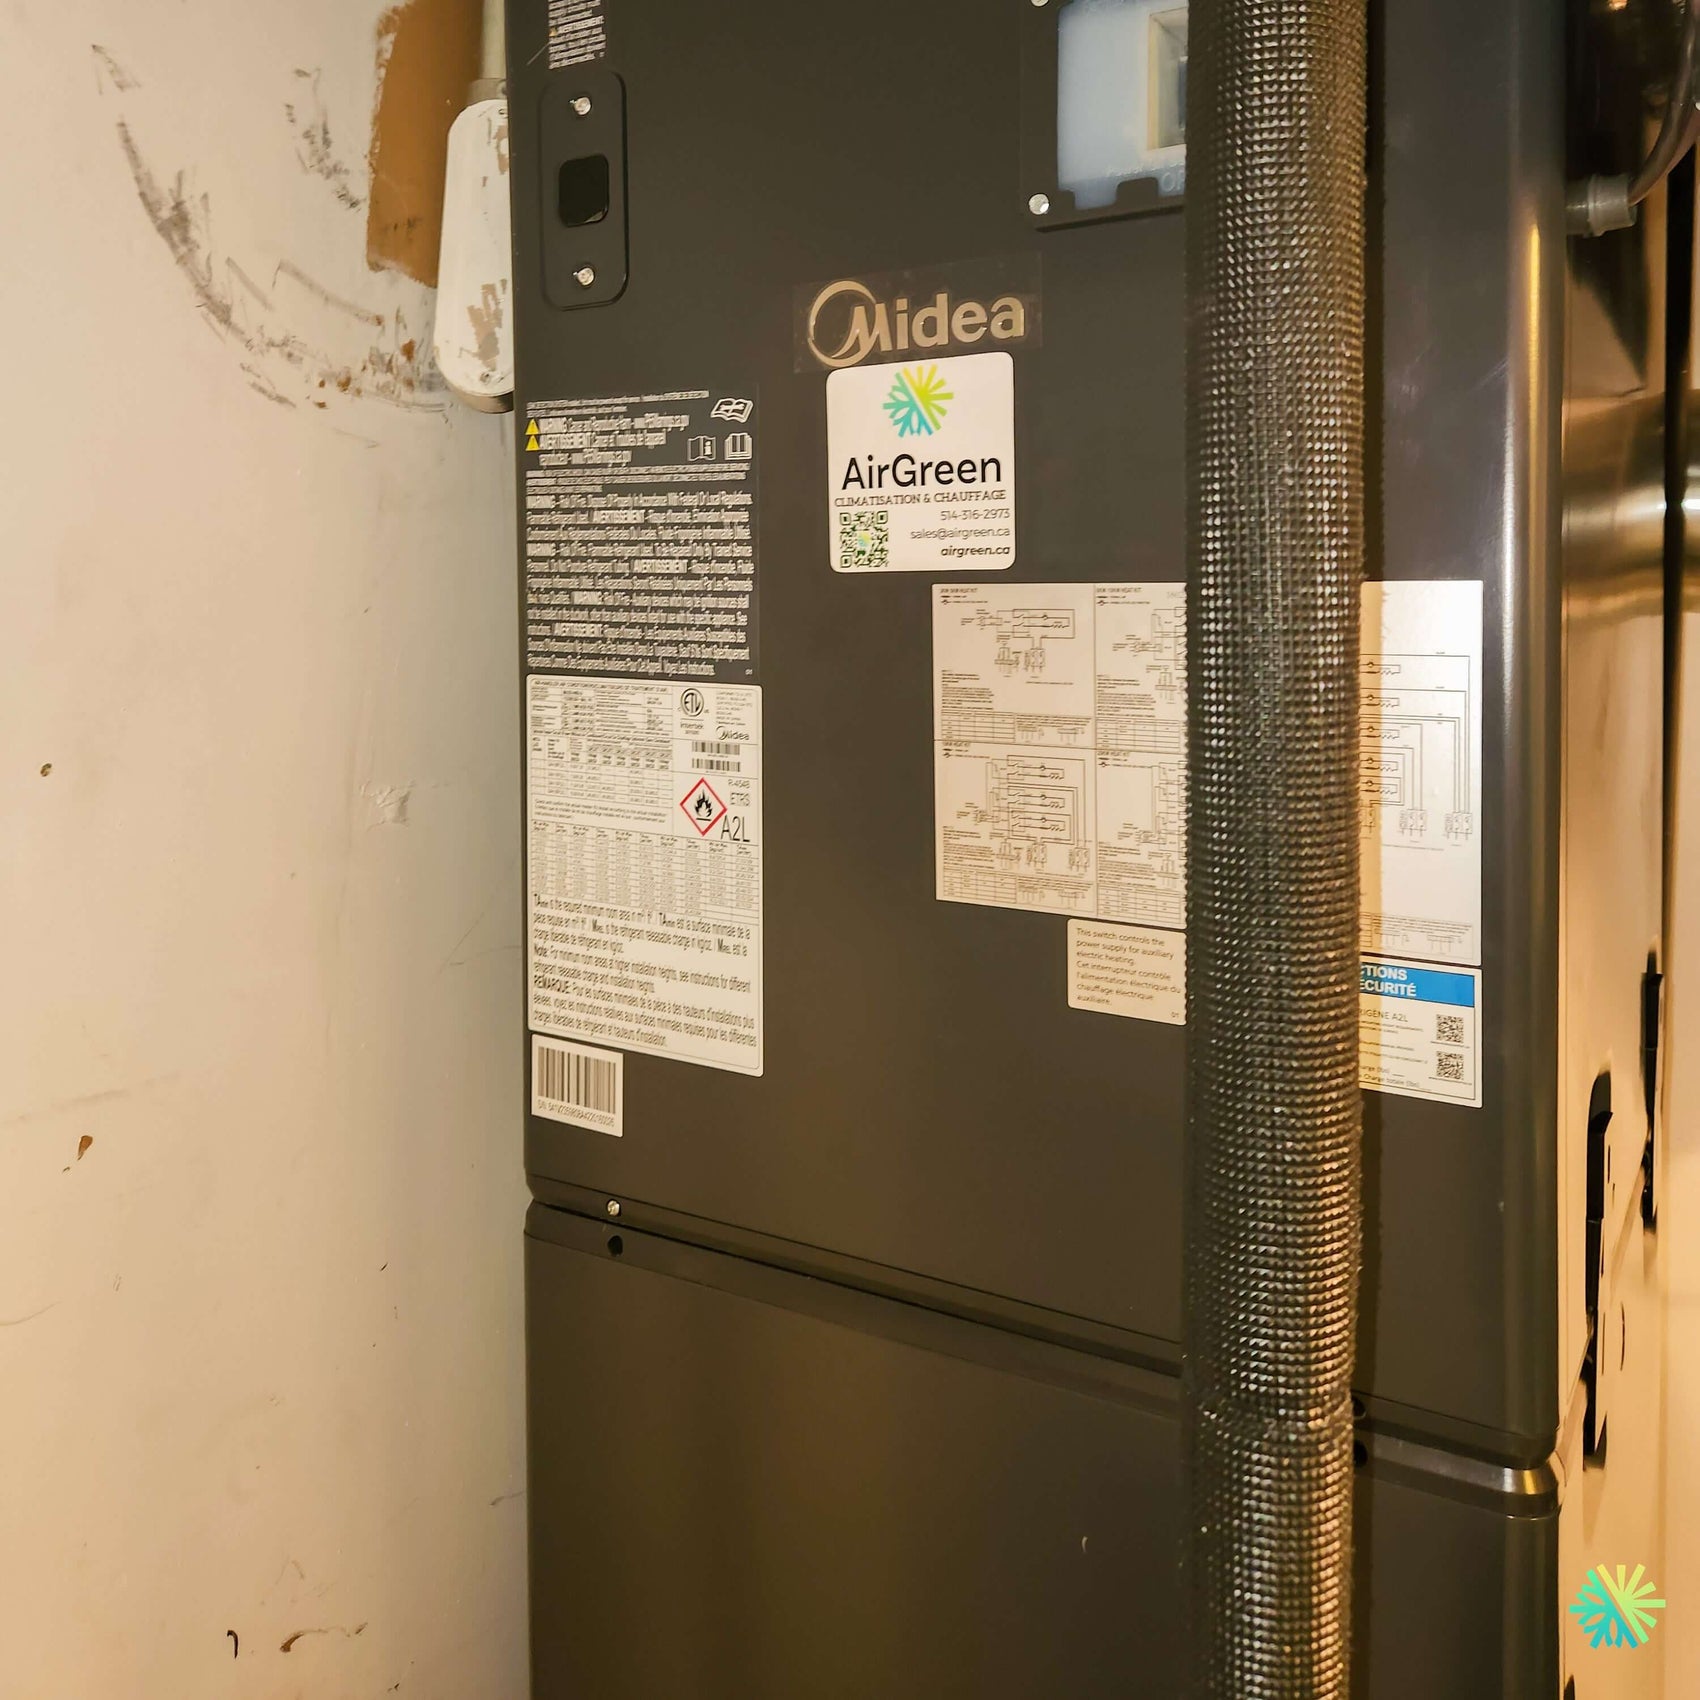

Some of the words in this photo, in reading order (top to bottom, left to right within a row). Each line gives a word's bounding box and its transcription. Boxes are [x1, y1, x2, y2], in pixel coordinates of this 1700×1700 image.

[808, 280, 1024, 368] Midea
[842, 454, 1001, 490] AirGreen
[834, 494, 920, 507] CLIMATISATION
[923, 494, 930, 502] &
[934, 490, 1006, 502] CHAUFFAGE
[940, 508, 1010, 520] 514-316-2973
[910, 527, 1010, 541] sales@airgreen.ca
[941, 546, 1010, 558] airgreen.ca
[720, 814, 750, 843] A2L
